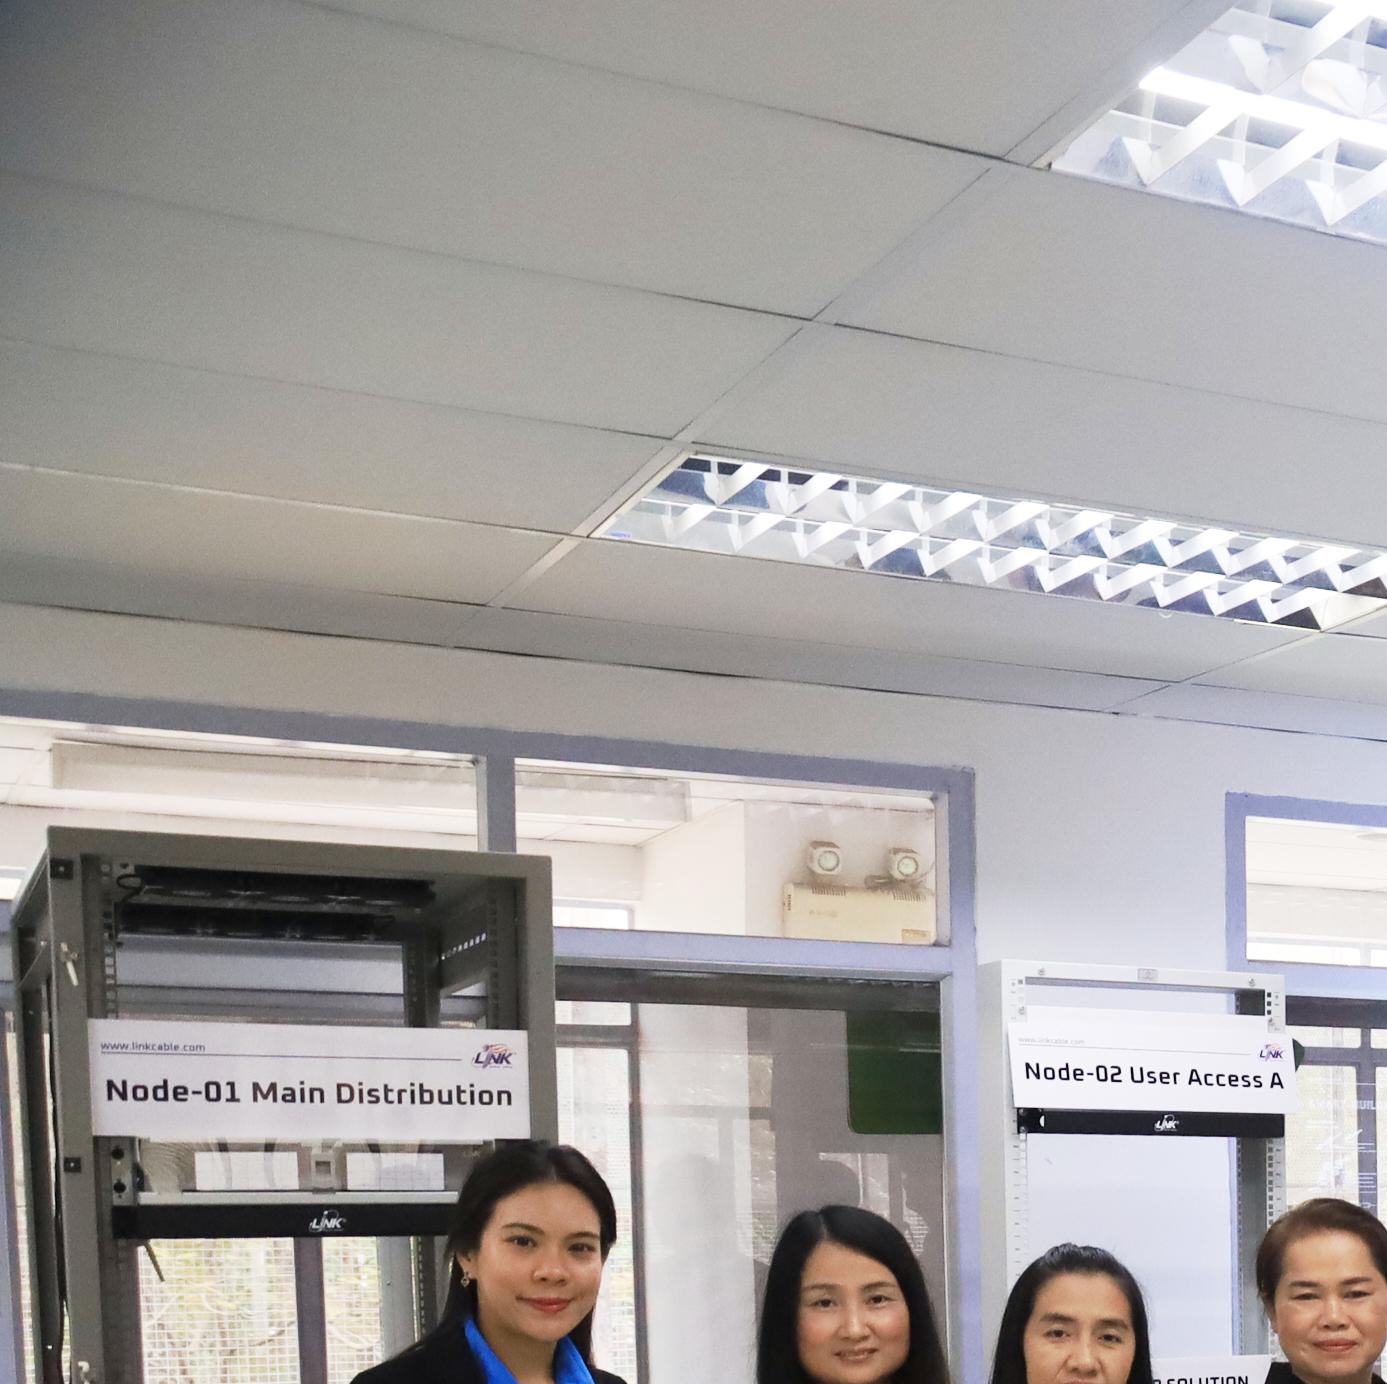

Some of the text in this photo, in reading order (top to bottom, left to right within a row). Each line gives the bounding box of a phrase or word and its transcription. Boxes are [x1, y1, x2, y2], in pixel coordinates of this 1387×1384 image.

[101, 1041, 206, 1052] www.linkcable.com
[473, 1044, 514, 1067] LINK
[1259, 1044, 1284, 1061] LINK
[1025, 1062, 1284, 1089] Node-02 User Access A
[106, 1079, 513, 1106] Node-01 Main Distribution
[308, 1211, 347, 1231] LINK
